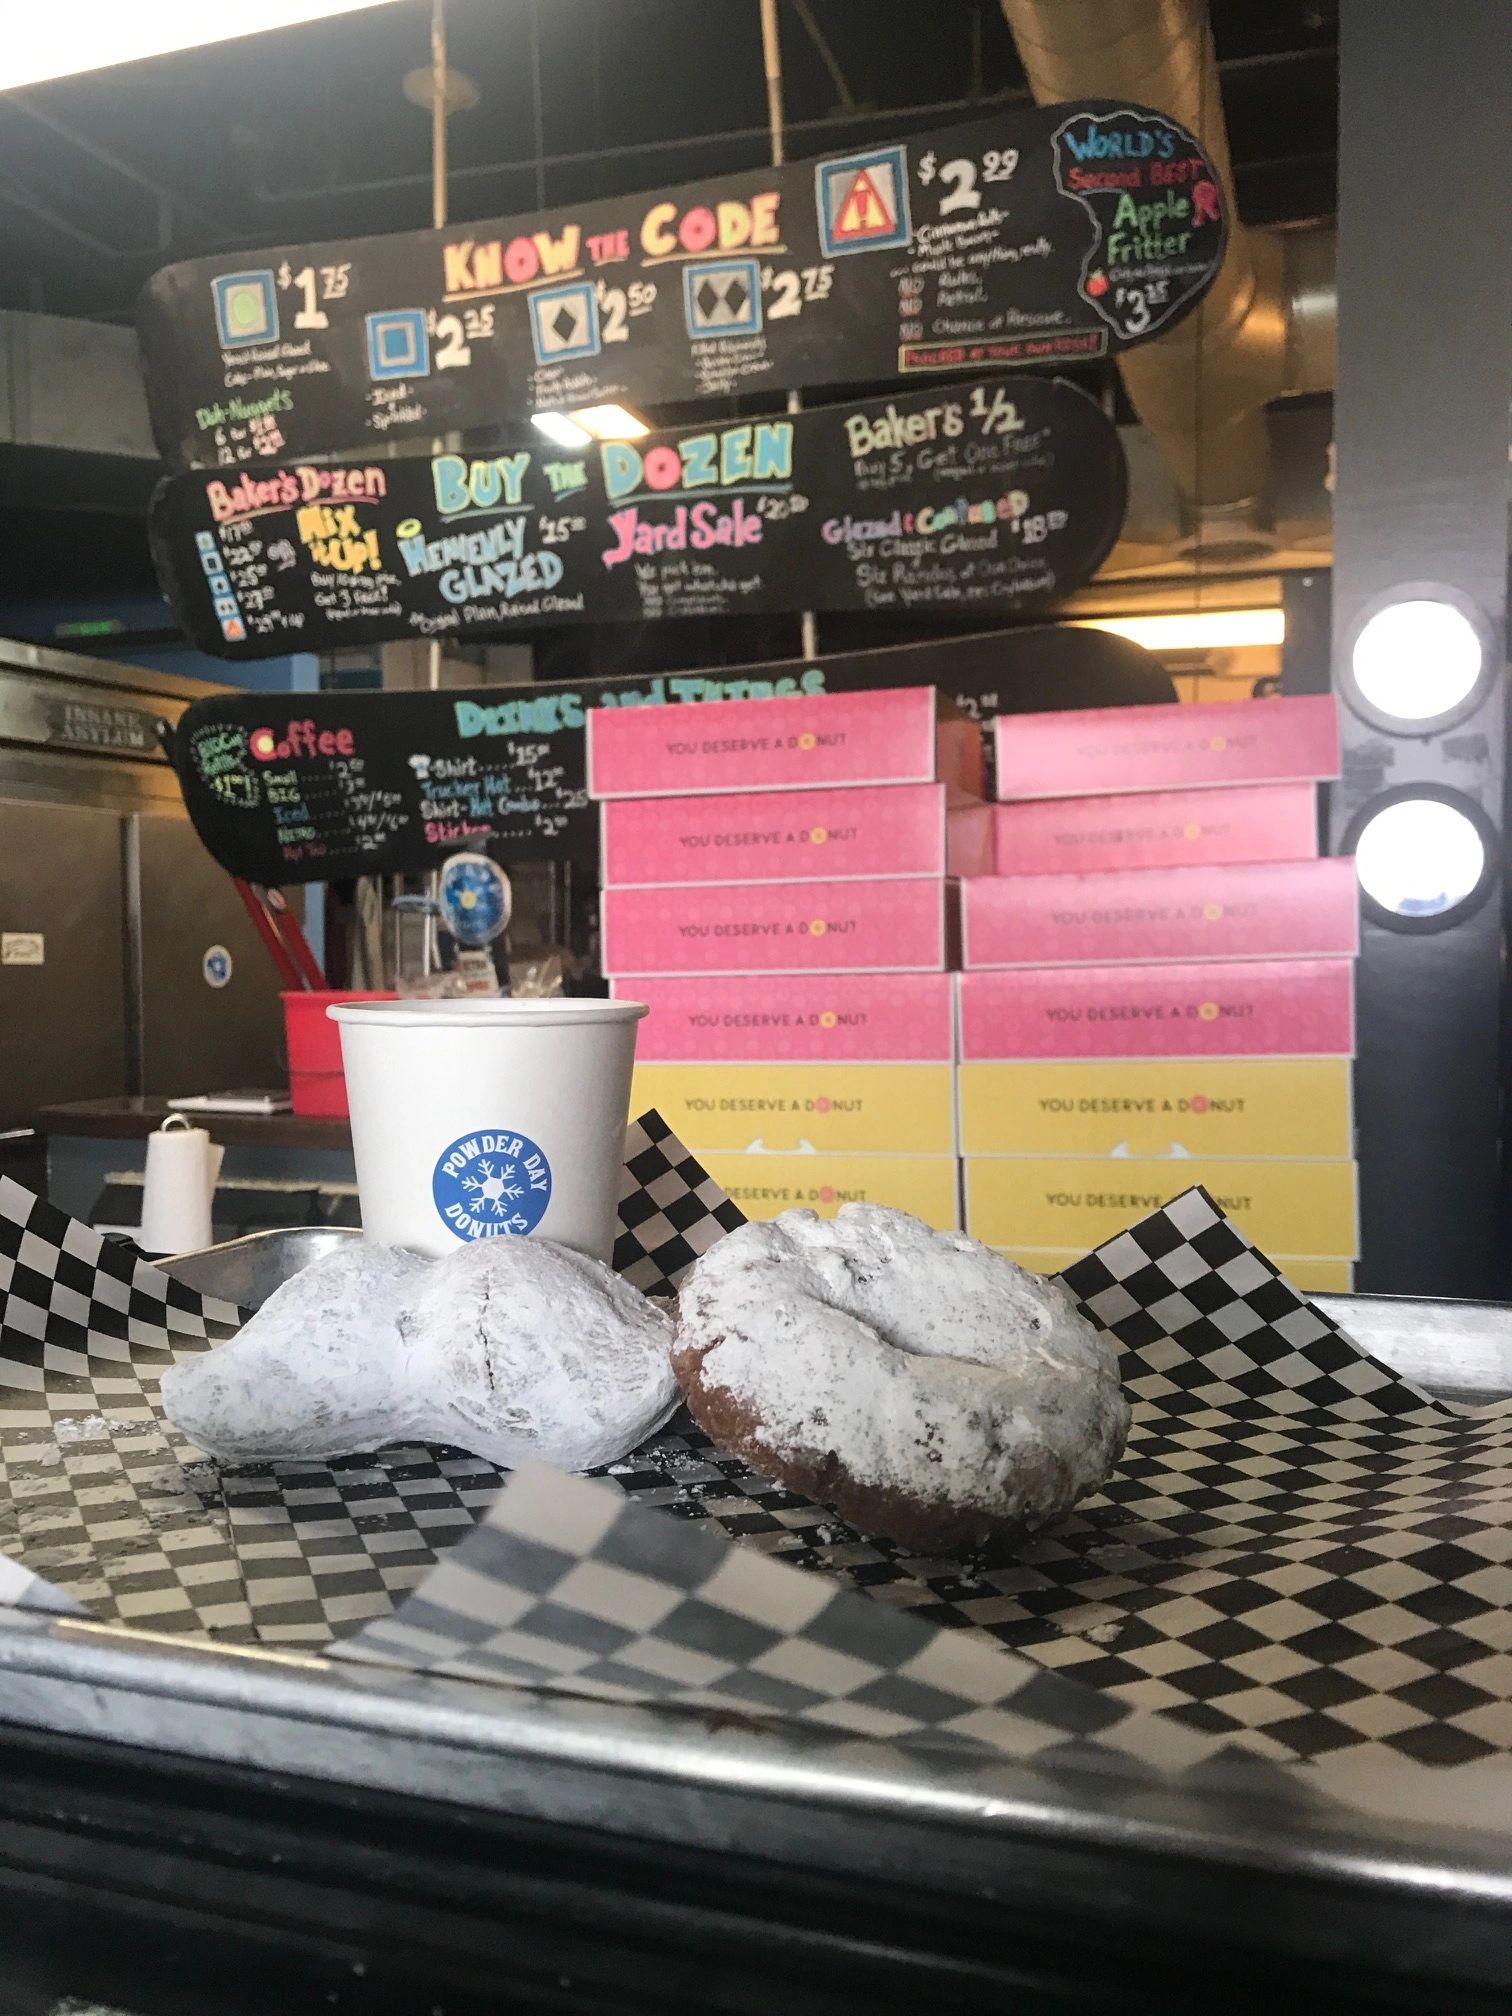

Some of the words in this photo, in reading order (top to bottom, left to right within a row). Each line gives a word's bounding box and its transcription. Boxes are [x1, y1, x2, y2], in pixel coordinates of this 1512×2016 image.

[1064, 125, 1175, 161] WORLD'S
[1112, 186, 1190, 237] Apple
[443, 224, 581, 291] KNOW
[586, 229, 629, 262] THE
[640, 192, 781, 257] CODE
[1108, 231, 1191, 265] Fritter
[845, 401, 964, 457] Baker's
[432, 453, 531, 514] BUY
[544, 461, 589, 492] THE
[602, 422, 794, 499] DOZEN
[205, 469, 299, 522] Baker's
[297, 465, 387, 501] Dozen
[297, 504, 361, 544] Mix
[602, 505, 688, 565] Yard
[690, 499, 763, 550] Sale
[438, 550, 565, 605] GLAZED
[453, 694, 586, 738] DRINKS
[250, 719, 355, 761] Coffee
[667, 743, 698, 755] YOU
[702, 738, 769, 754] DESERVE
[788, 732, 846, 750] DONUT
[262, 769, 298, 786] Small
[680, 835, 710, 847] YOU
[714, 831, 780, 846] DESERVE
[801, 826, 857, 845] DONUT
[680, 926, 709, 938] YOU
[714, 923, 779, 937] DESERVE
[800, 918, 856, 938] DONUT
[688, 1014, 718, 1026] YOU
[724, 1014, 789, 1027] DESERVE
[809, 1011, 867, 1029] DONUT
[1047, 1008, 1081, 1021] YOU
[1088, 1006, 1164, 1020] DESERVE
[1186, 1002, 1253, 1021] DONUT
[685, 1099, 715, 1111] YOU
[720, 1099, 785, 1111] DESERVE
[806, 1095, 862, 1114] DONUT
[1039, 1098, 1073, 1113] YOU
[1080, 1098, 1155, 1113] DESERVE
[1179, 1094, 1245, 1115] DONUT
[442, 1135, 524, 1178] POWDER
[523, 1152, 548, 1191] DAY
[724, 1187, 783, 1200] DESERVE
[809, 1185, 866, 1204] DONUT
[1046, 1193, 1080, 1207] YOU
[1086, 1193, 1162, 1208] DESERVE
[444, 1202, 528, 1238] DONUTS
